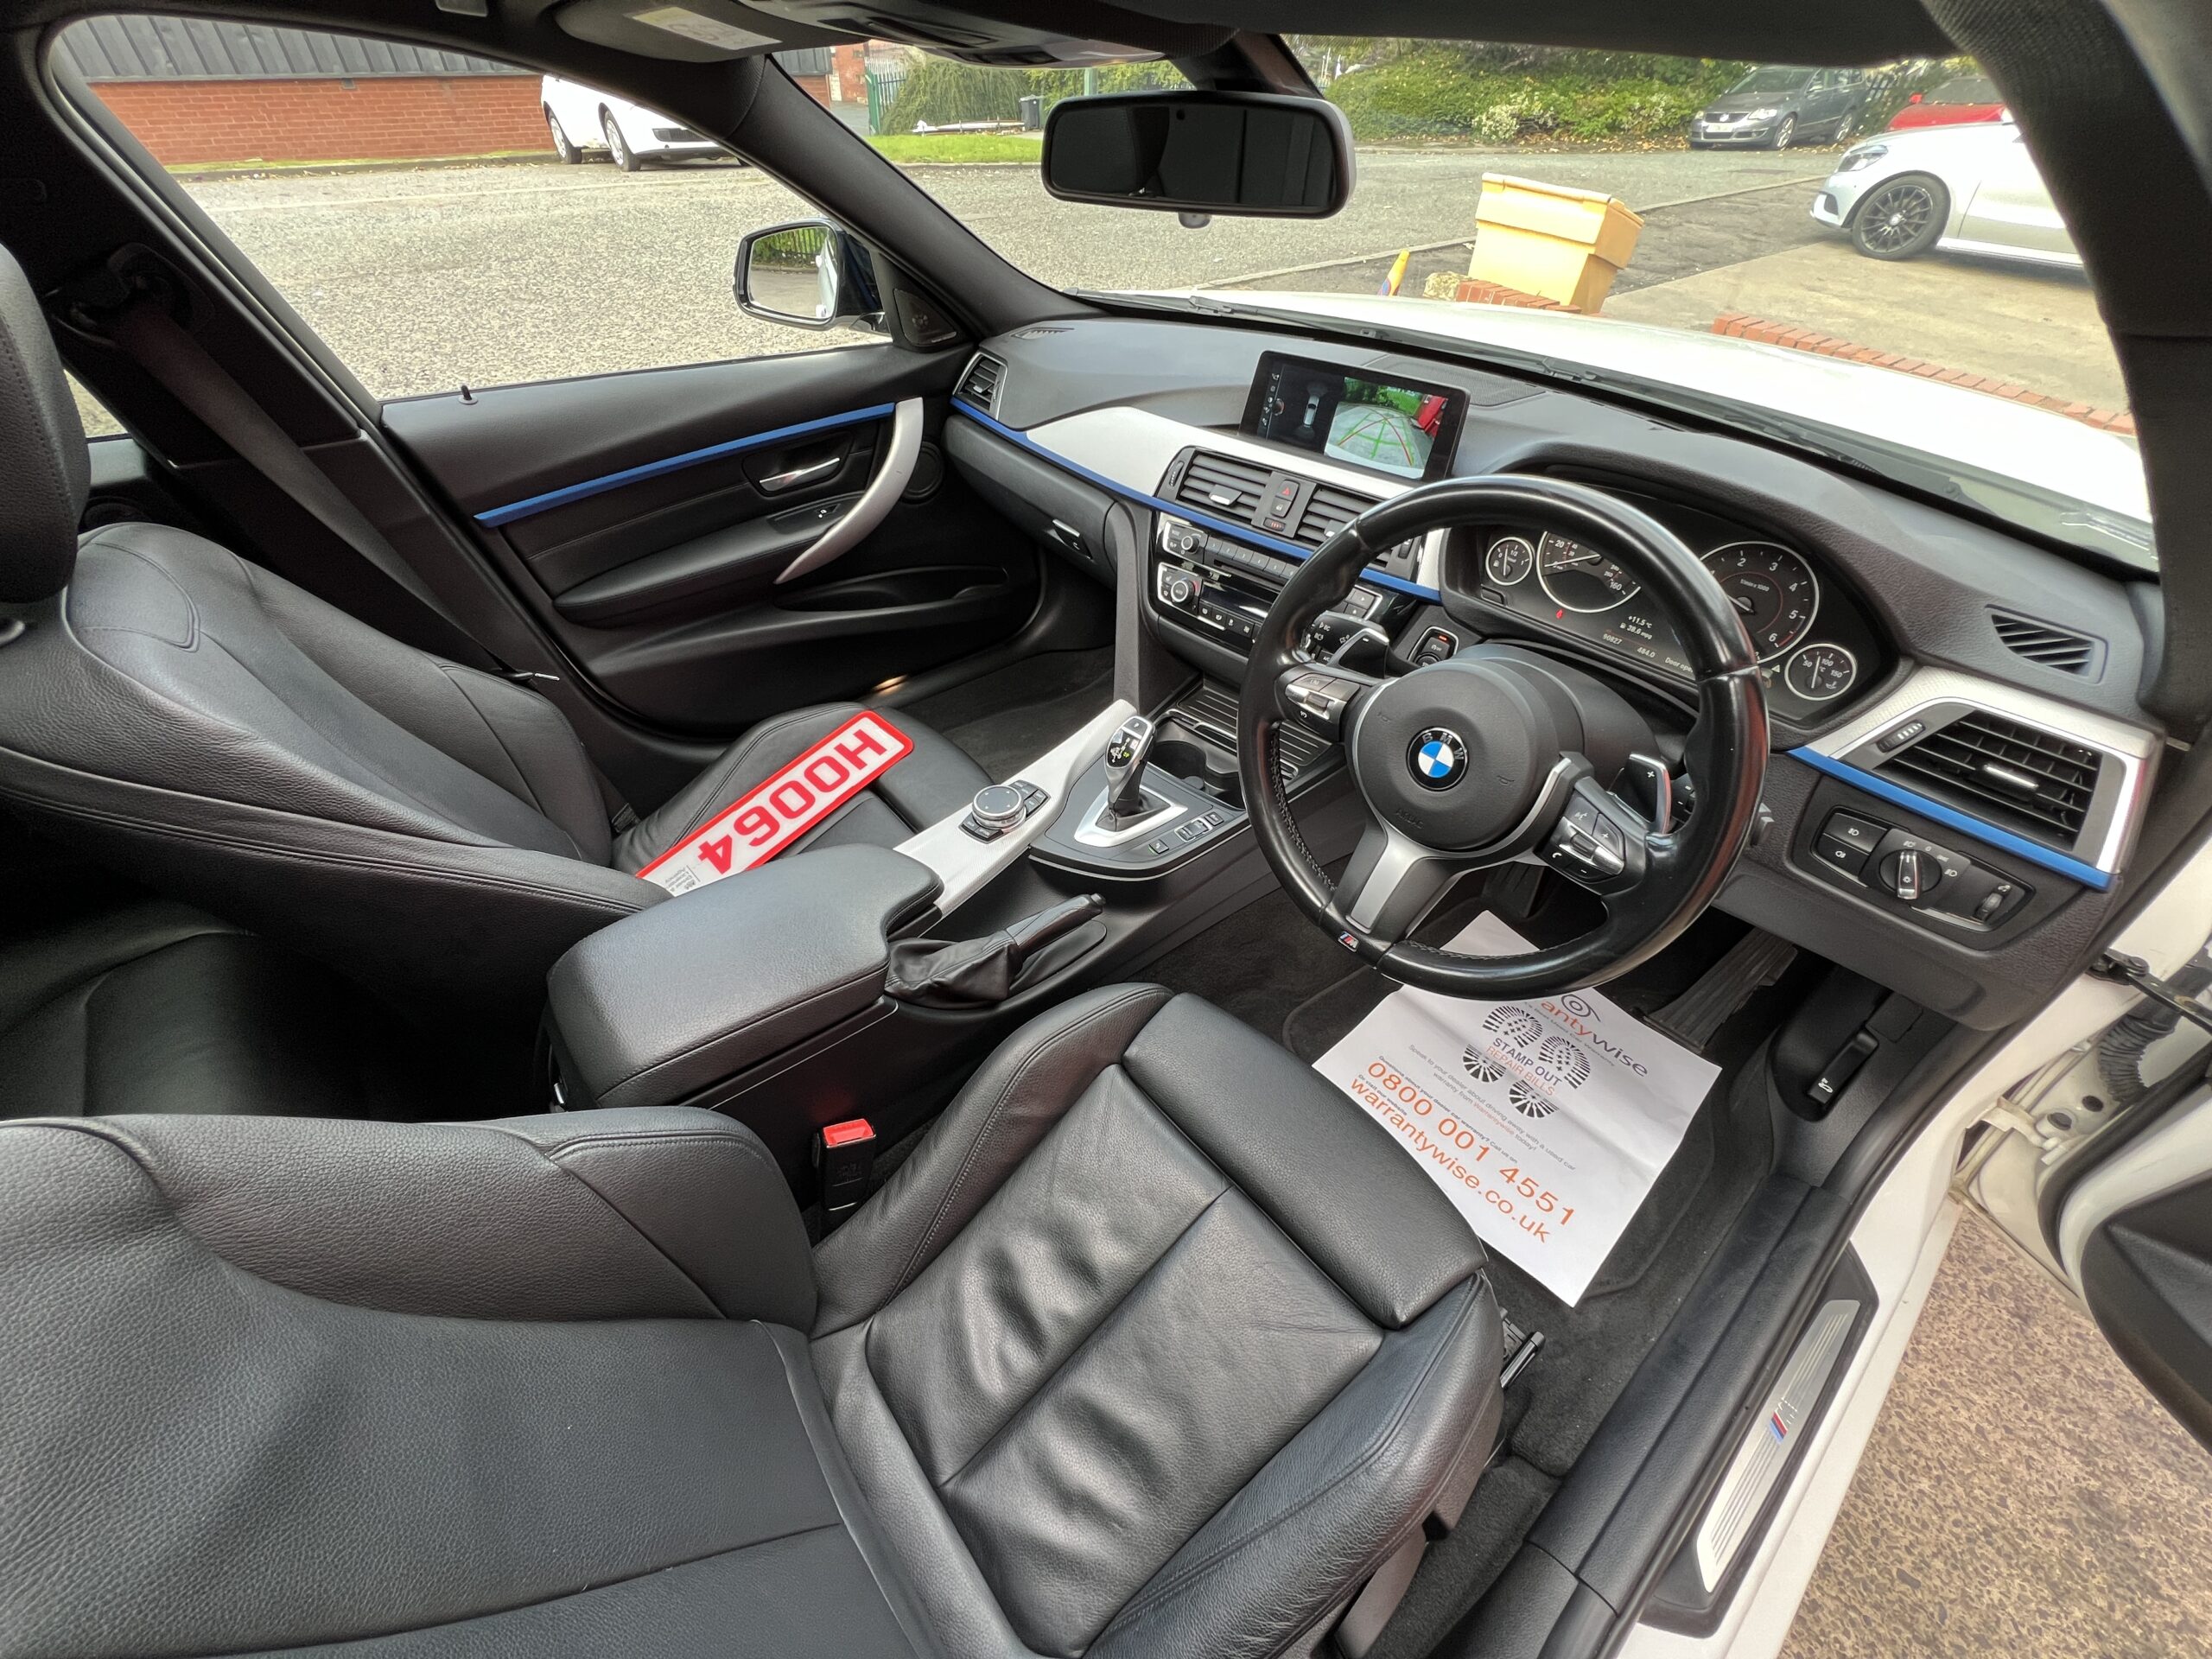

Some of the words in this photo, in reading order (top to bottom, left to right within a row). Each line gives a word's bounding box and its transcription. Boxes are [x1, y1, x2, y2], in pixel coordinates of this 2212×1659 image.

[1555, 539, 1564, 549] 20
[1737, 557, 1746, 567] 2
[1769, 562, 1778, 571] 3
[1610, 581, 1622, 591] 160
[1789, 582, 1798, 592] 4
[1789, 609, 1798, 620] 5
[1768, 632, 1777, 642] 6
[1802, 659, 1813, 668] 50
[1821, 658, 1834, 667] 100
[1830, 669, 1843, 678] 150
[1422, 732, 1465, 760] BMW
[1541, 1000, 1648, 1077] antywise
[1493, 1037, 1535, 1067] STAMP
[1536, 1065, 1561, 1085] OUT
[1486, 1046, 1523, 1074] REPAIR
[1523, 1072, 1554, 1096] BILLS
[1433, 1073, 1459, 1092] warranty
[1459, 1091, 1472, 1103] from
[1433, 1065, 1447, 1075] your
[1448, 1075, 1467, 1089] dealer
[1467, 1090, 1485, 1104] about
[1484, 1103, 1507, 1122] driving
[1508, 1120, 1524, 1134] away
[1526, 1133, 1539, 1144] with
[1545, 1148, 1563, 1162] used
[1367, 1062, 1433, 1116] 0800
[1438, 1117, 1490, 1163] 001
[1499, 1166, 1575, 1227] 4551
[1351, 1077, 1551, 1243] warrantywise.co.uk
